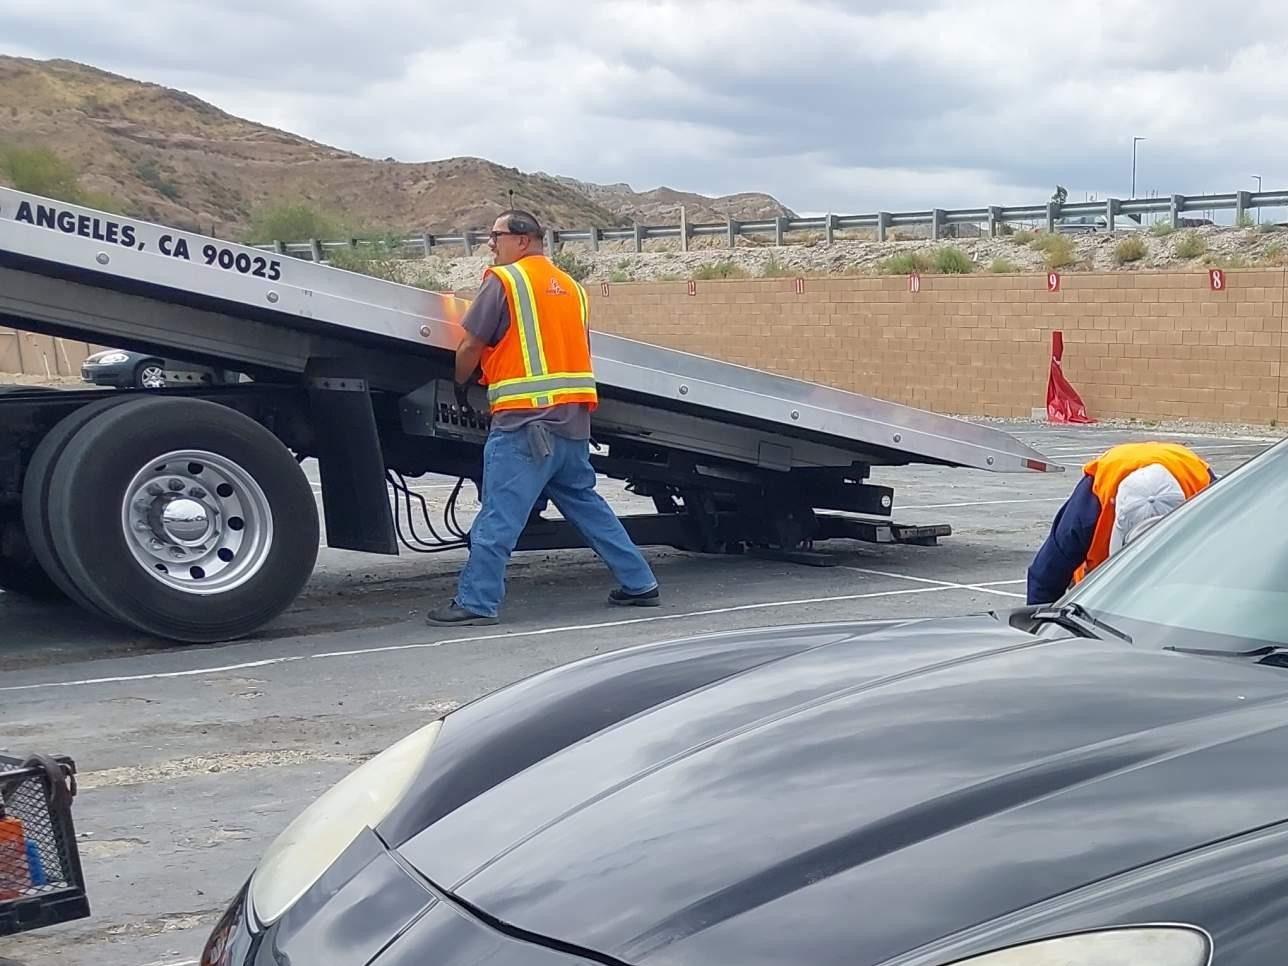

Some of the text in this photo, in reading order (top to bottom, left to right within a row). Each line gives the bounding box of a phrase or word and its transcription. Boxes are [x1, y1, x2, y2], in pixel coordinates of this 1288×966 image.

[15, 201, 281, 281] ANGELES, CA 90025
[796, 279, 804, 293] 11
[910, 275, 920, 293] 10
[1048, 273, 1058, 291] 9
[1211, 270, 1223, 290] 8
